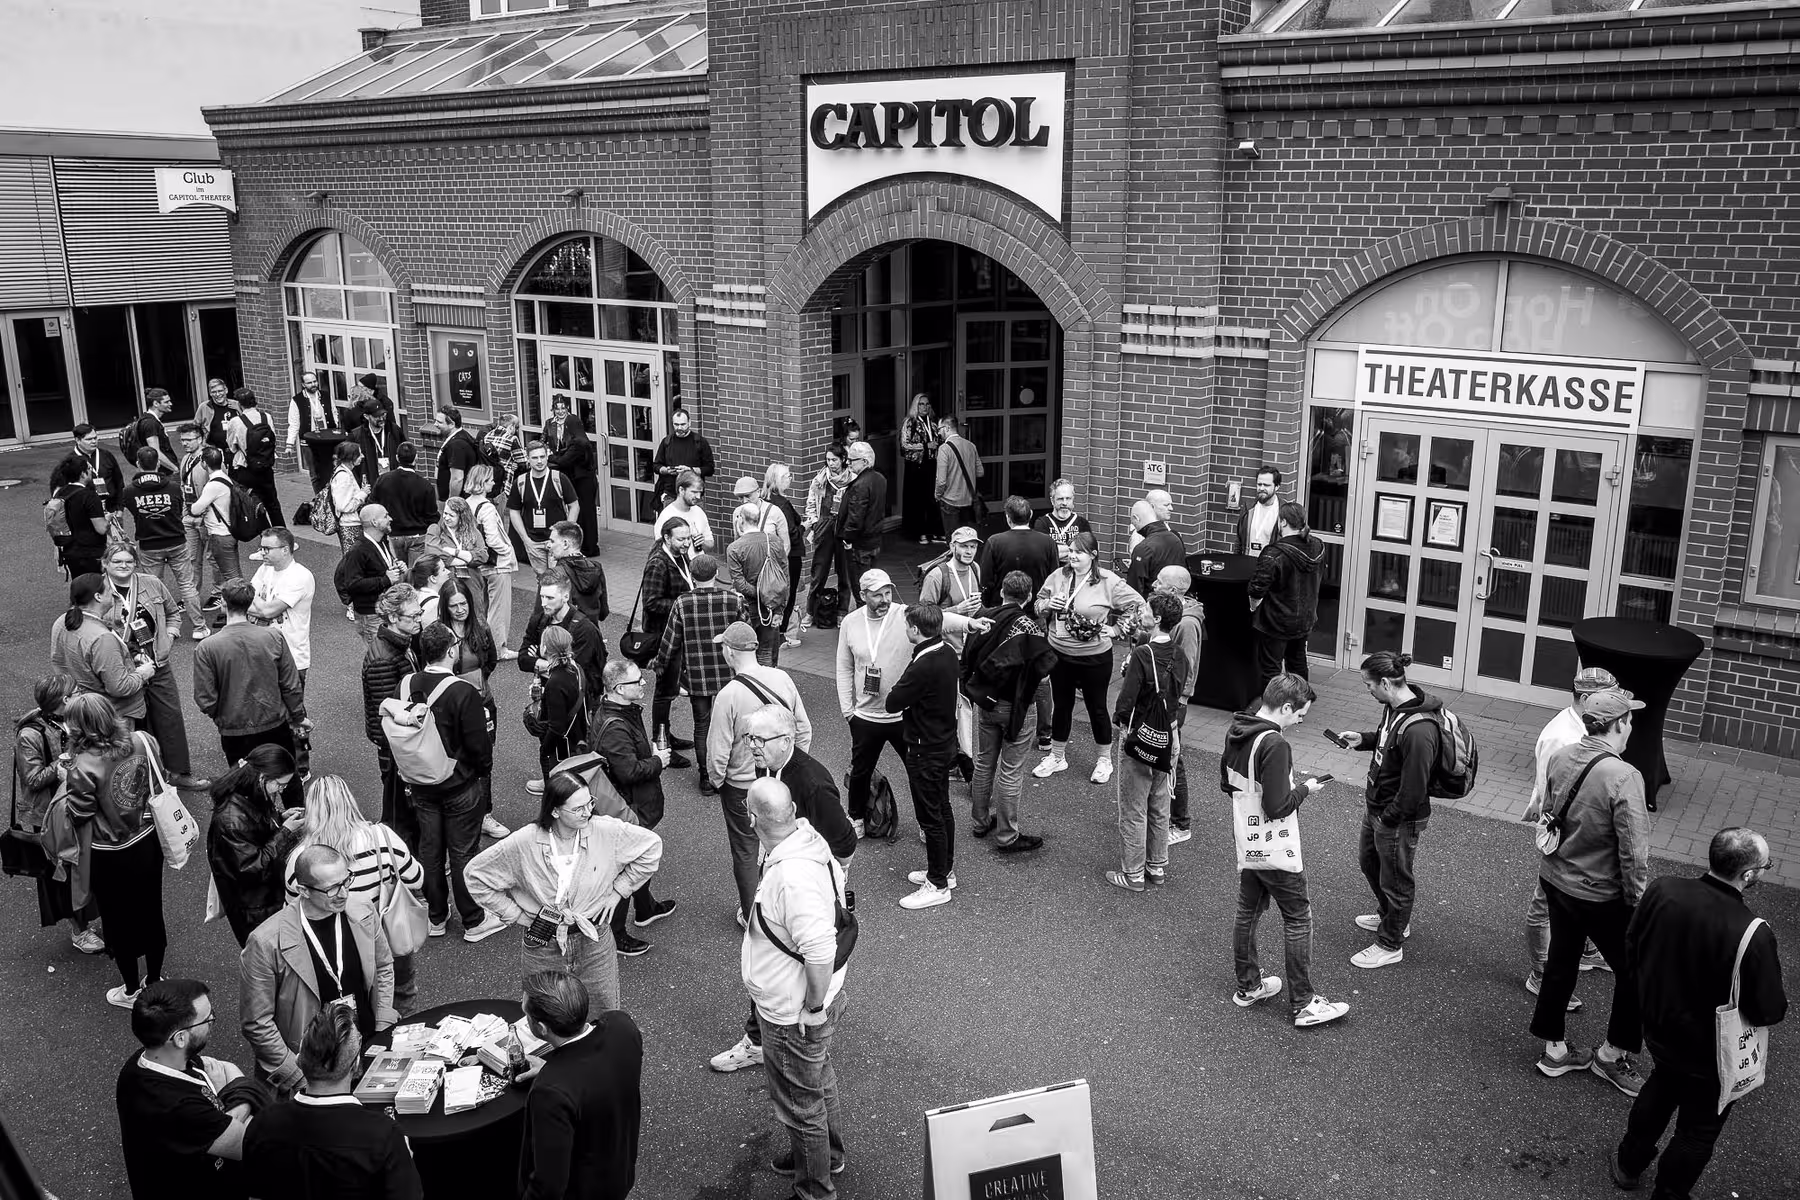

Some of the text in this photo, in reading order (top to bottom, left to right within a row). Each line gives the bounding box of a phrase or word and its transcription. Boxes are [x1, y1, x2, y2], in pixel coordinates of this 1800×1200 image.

[810, 96, 1050, 150] CAPITOL
[183, 171, 215, 184] Club
[458, 371, 472, 383] CATS
[1364, 362, 1636, 414] THEATERKASSE
[134, 493, 172, 508] MEER
[984, 1169, 1049, 1199] CREATIVE
